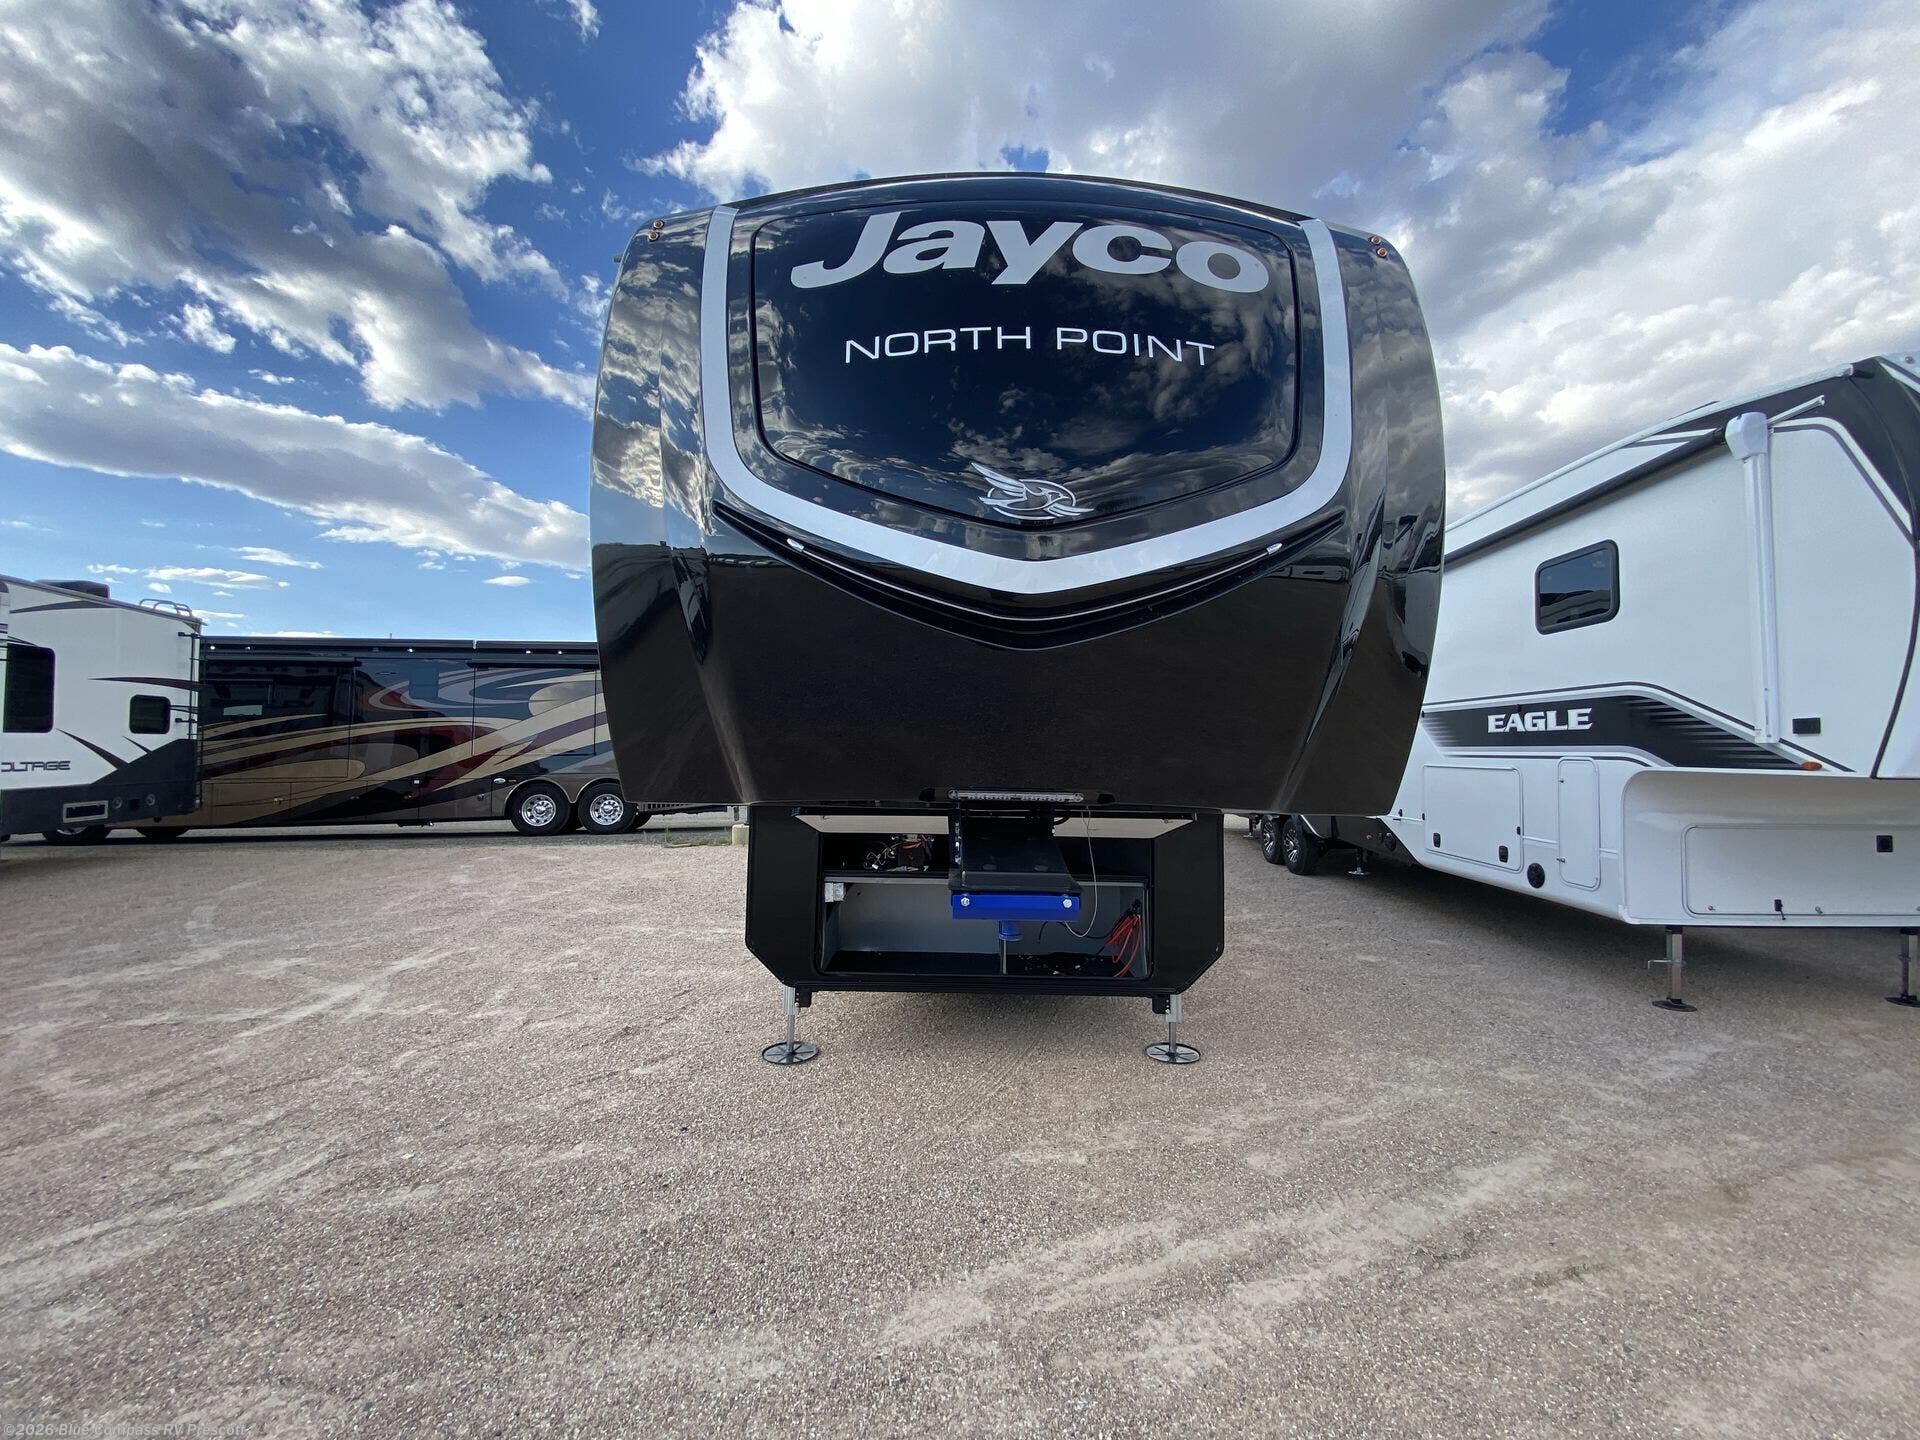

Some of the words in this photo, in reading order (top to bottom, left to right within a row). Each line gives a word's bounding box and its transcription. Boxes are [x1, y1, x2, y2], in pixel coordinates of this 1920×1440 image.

[790, 211, 1270, 293] Jayco
[845, 326, 1031, 364] NORTH
[1056, 327, 1215, 366] POINT
[1487, 707, 1593, 734] EAGLE
